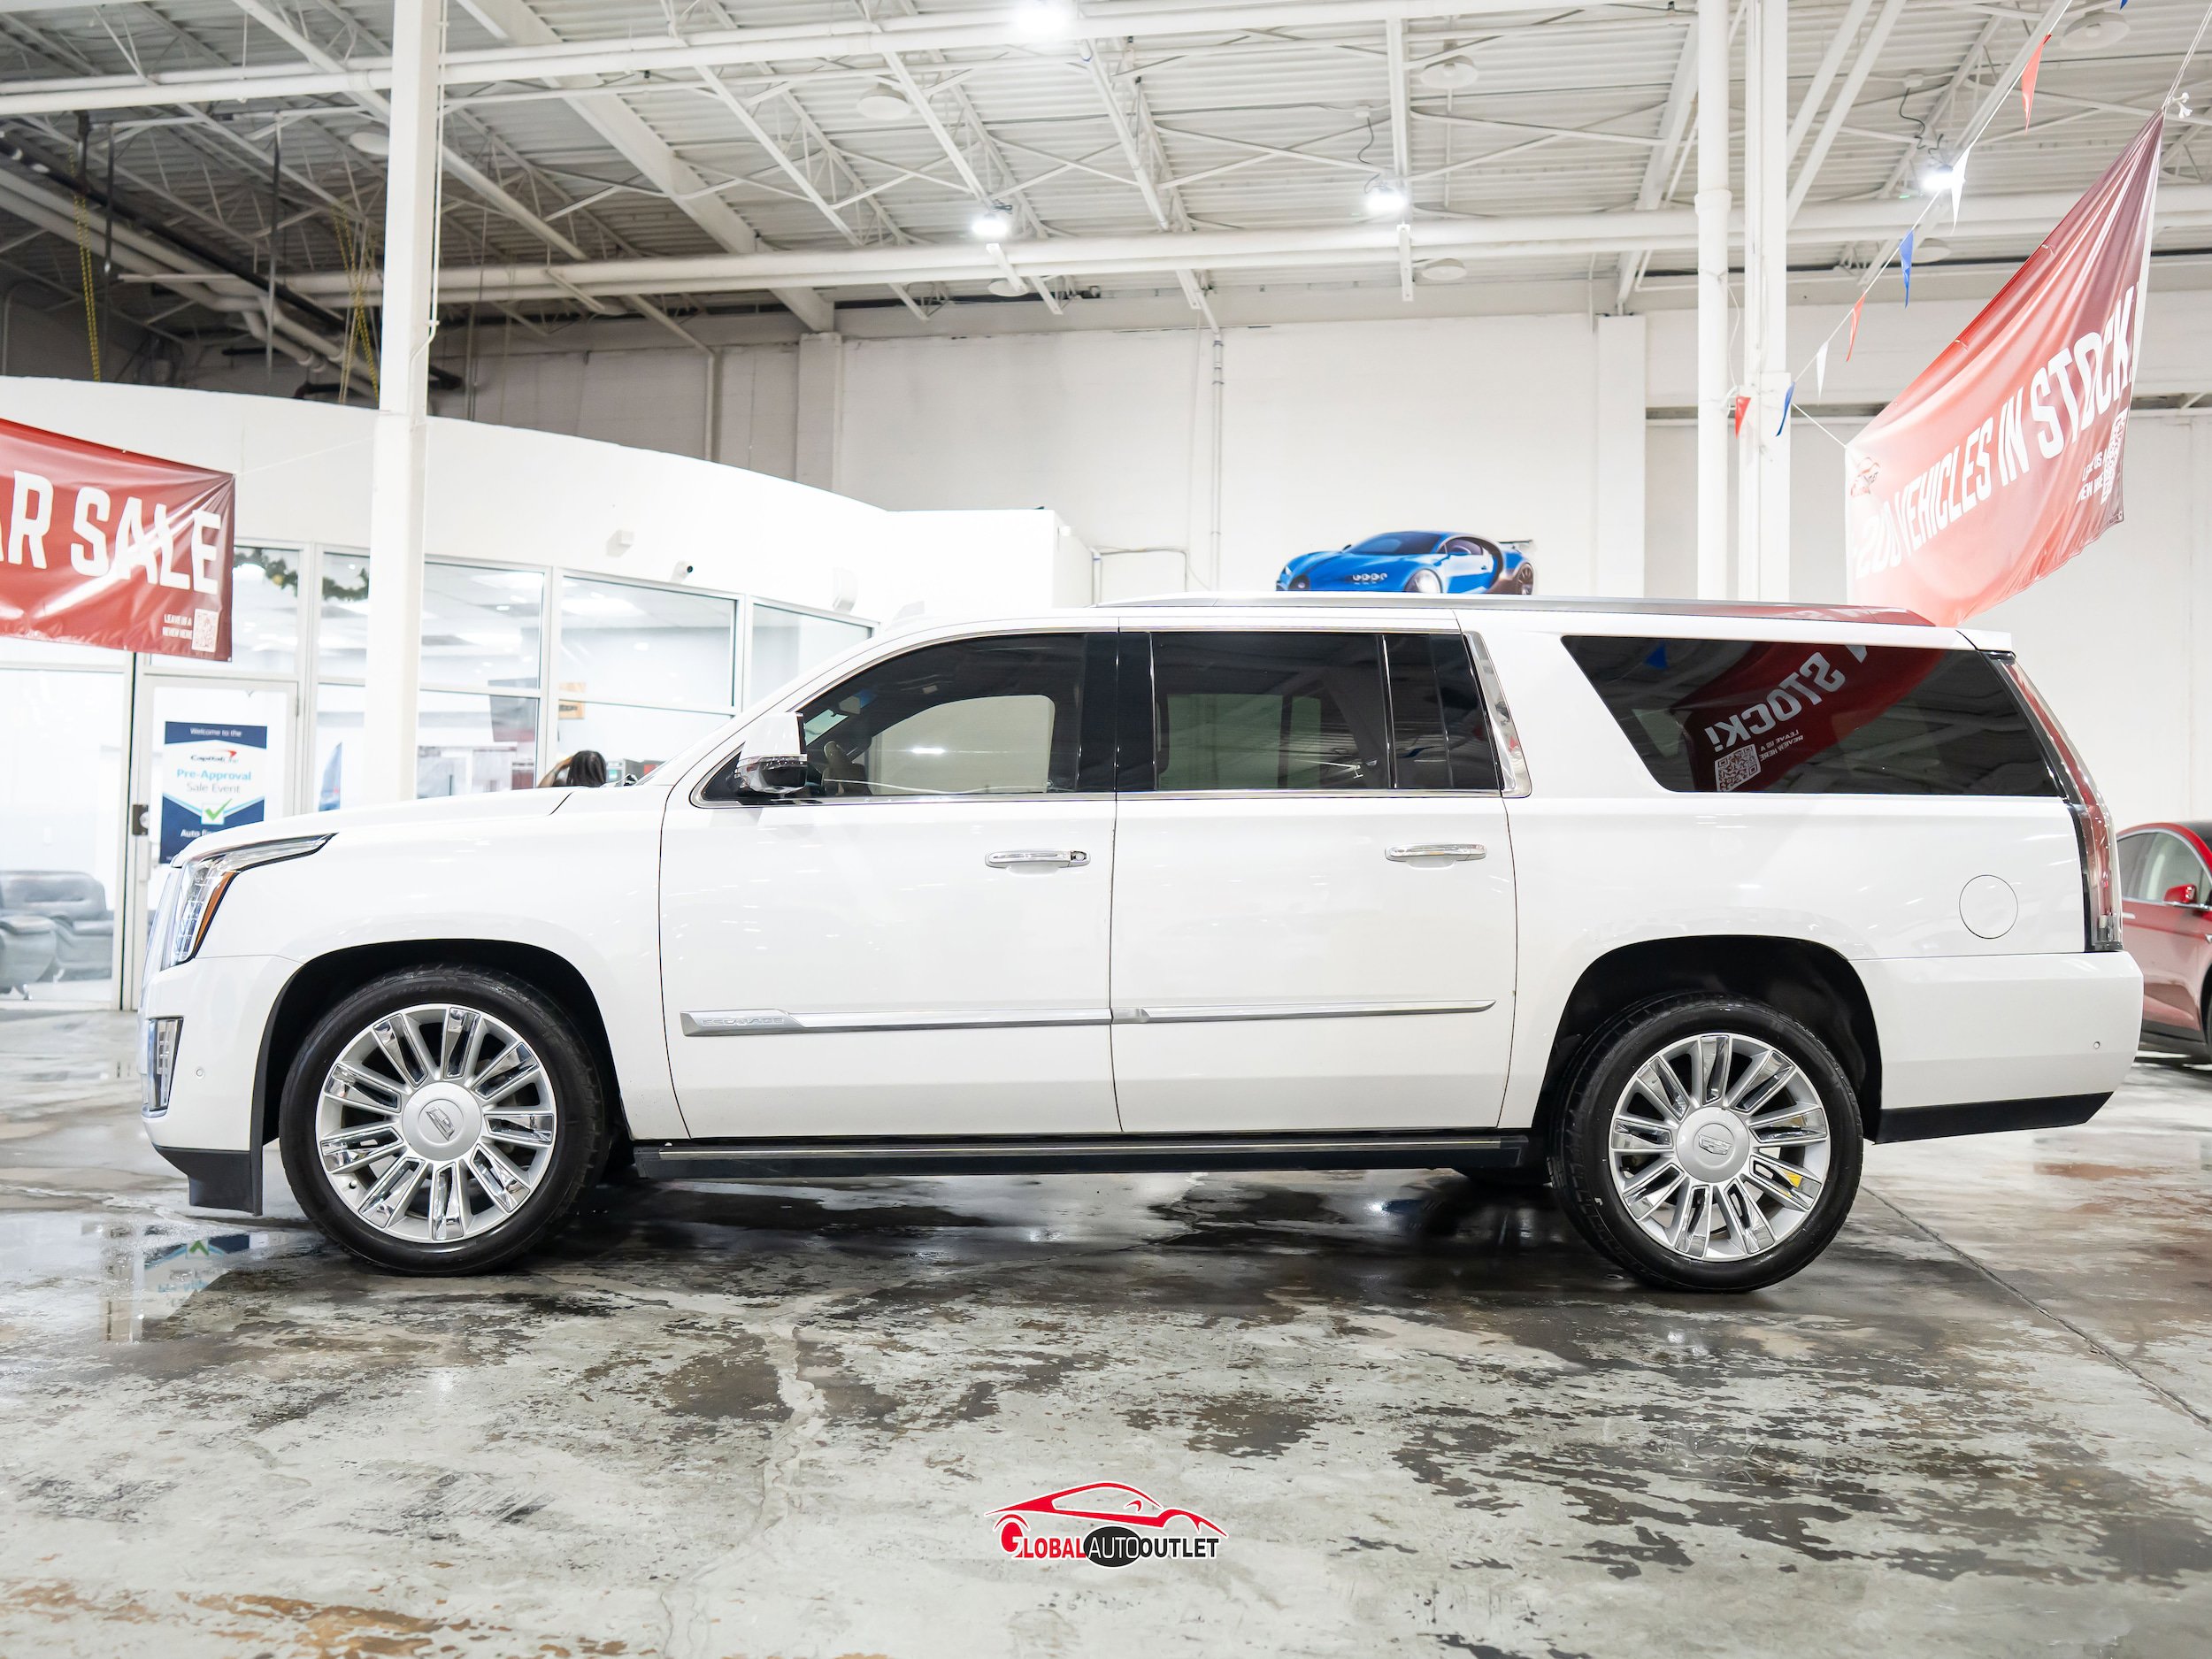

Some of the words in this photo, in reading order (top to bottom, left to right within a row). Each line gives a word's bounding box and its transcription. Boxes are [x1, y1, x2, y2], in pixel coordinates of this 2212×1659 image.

[1895, 417, 1993, 557] VEHICLES
[1998, 386, 2030, 487] IN
[2030, 282, 2138, 459] STOCK
[0, 470, 54, 569] R
[71, 487, 221, 595] SALE
[189, 727, 220, 736] Welcome
[176, 769, 251, 781] Pre-Approval
[187, 782, 208, 793] Sale
[211, 783, 241, 794] Event
[180, 829, 200, 838] Auto
